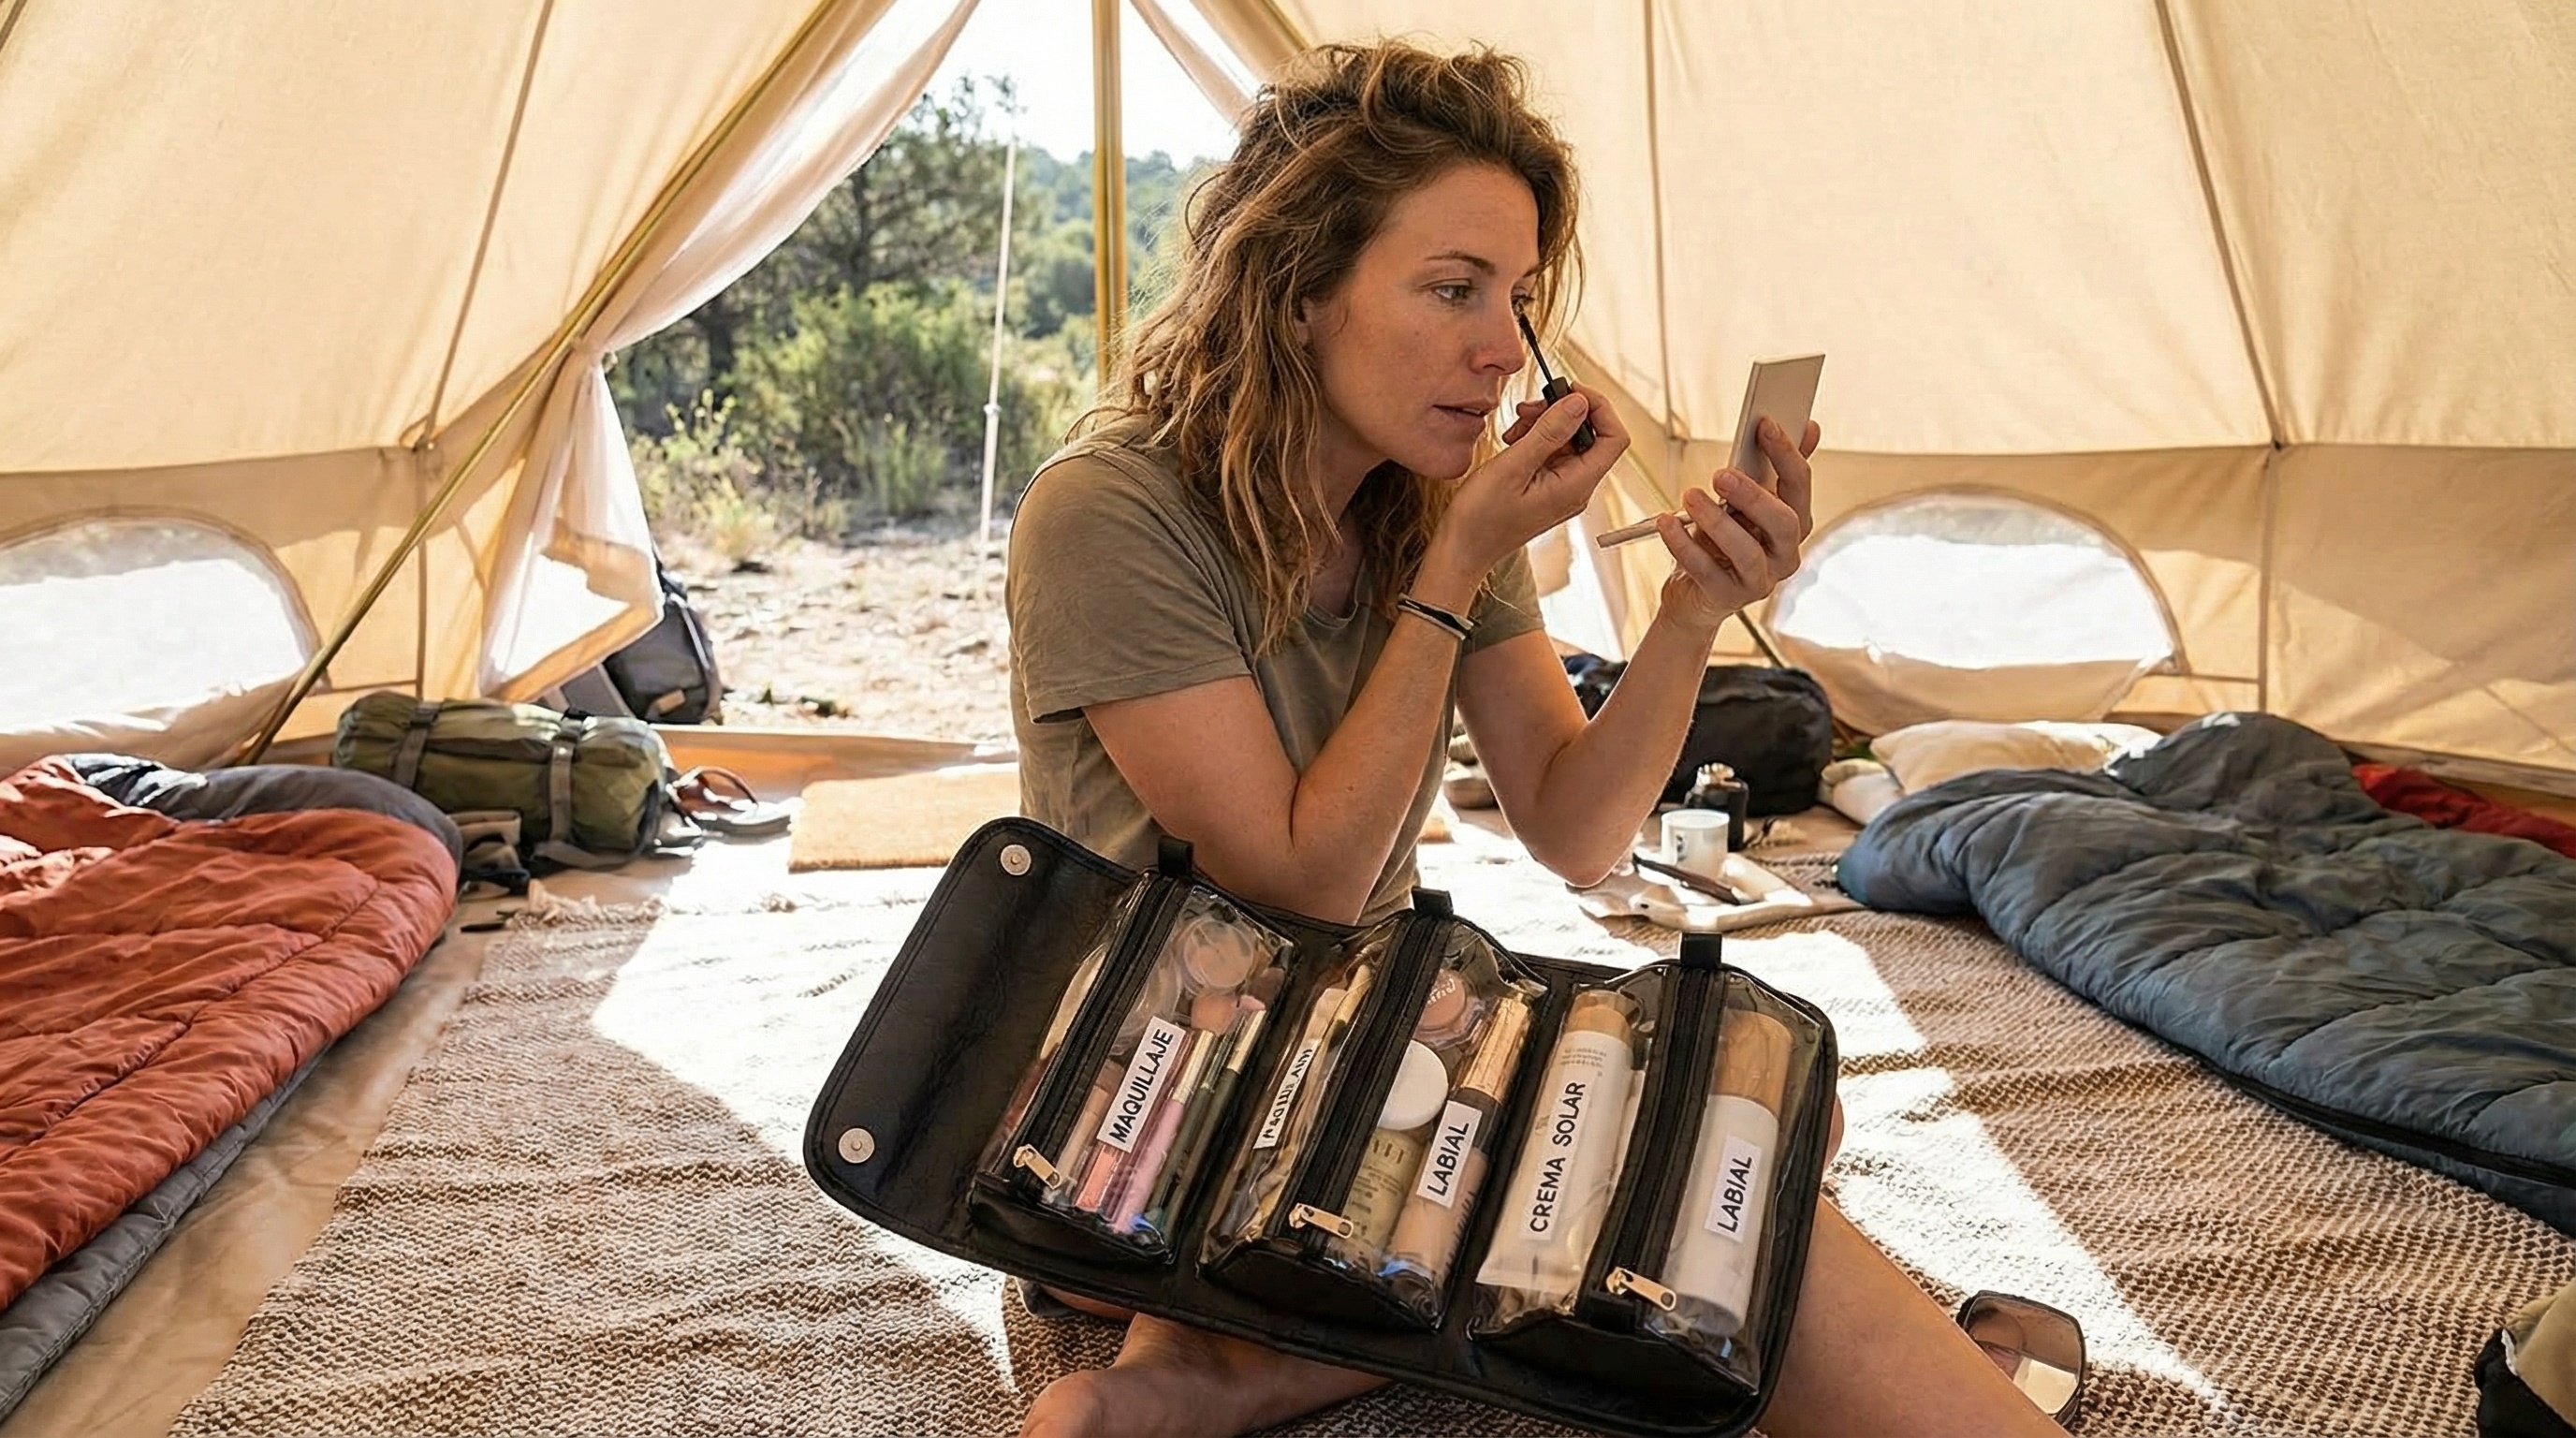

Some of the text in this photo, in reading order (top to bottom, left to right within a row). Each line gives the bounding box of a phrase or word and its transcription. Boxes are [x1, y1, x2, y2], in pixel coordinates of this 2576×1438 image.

[1110, 1029, 1173, 1144] MAQUILLAJE
[1427, 1123, 1469, 1196] LABIAL
[1530, 1157, 1565, 1232] CREMA
[1553, 1082, 1586, 1147] SOLAR
[1718, 1157, 1752, 1232] LABIAL
